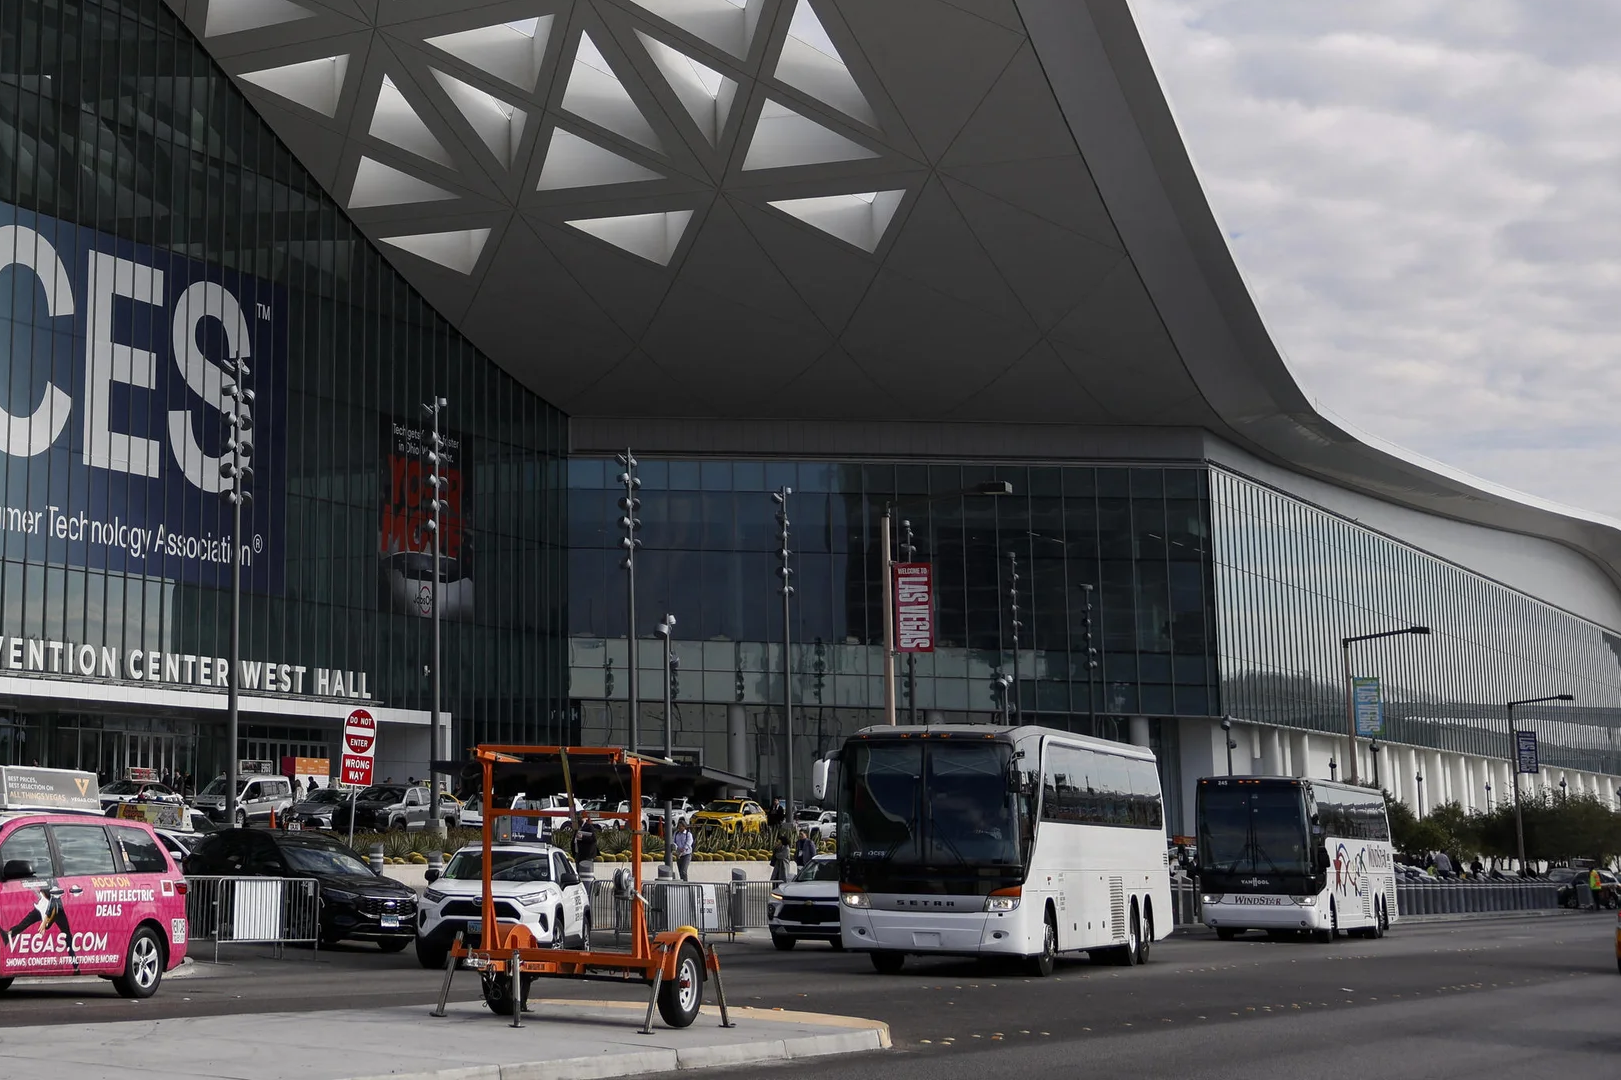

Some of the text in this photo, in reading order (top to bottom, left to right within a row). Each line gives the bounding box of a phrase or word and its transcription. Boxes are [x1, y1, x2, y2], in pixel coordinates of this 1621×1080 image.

[45, 505, 152, 559] Technology
[897, 567, 928, 575] WELCOME TO
[898, 576, 930, 648] LAS VEGAS
[128, 648, 228, 688] CENTER
[242, 660, 307, 694] WEST
[316, 667, 372, 700] HALL
[349, 716, 372, 726] DO NOT
[350, 738, 368, 748] ENTER
[345, 758, 370, 770] WRONG
[349, 770, 365, 781] WAY
[20, 783, 46, 791] SELECTION
[21, 791, 44, 800] THINGS
[91, 876, 130, 888] ROCK ON
[95, 889, 155, 902] WITH ELECTRIC
[896, 899, 955, 907] SETRA
[95, 904, 122, 917] DEALS
[7, 931, 108, 954] VEGAS.COM
[5, 957, 27, 968] SHOWS,
[27, 956, 58, 967] CONCERTS,
[58, 955, 96, 966] ATTRACTIONS
